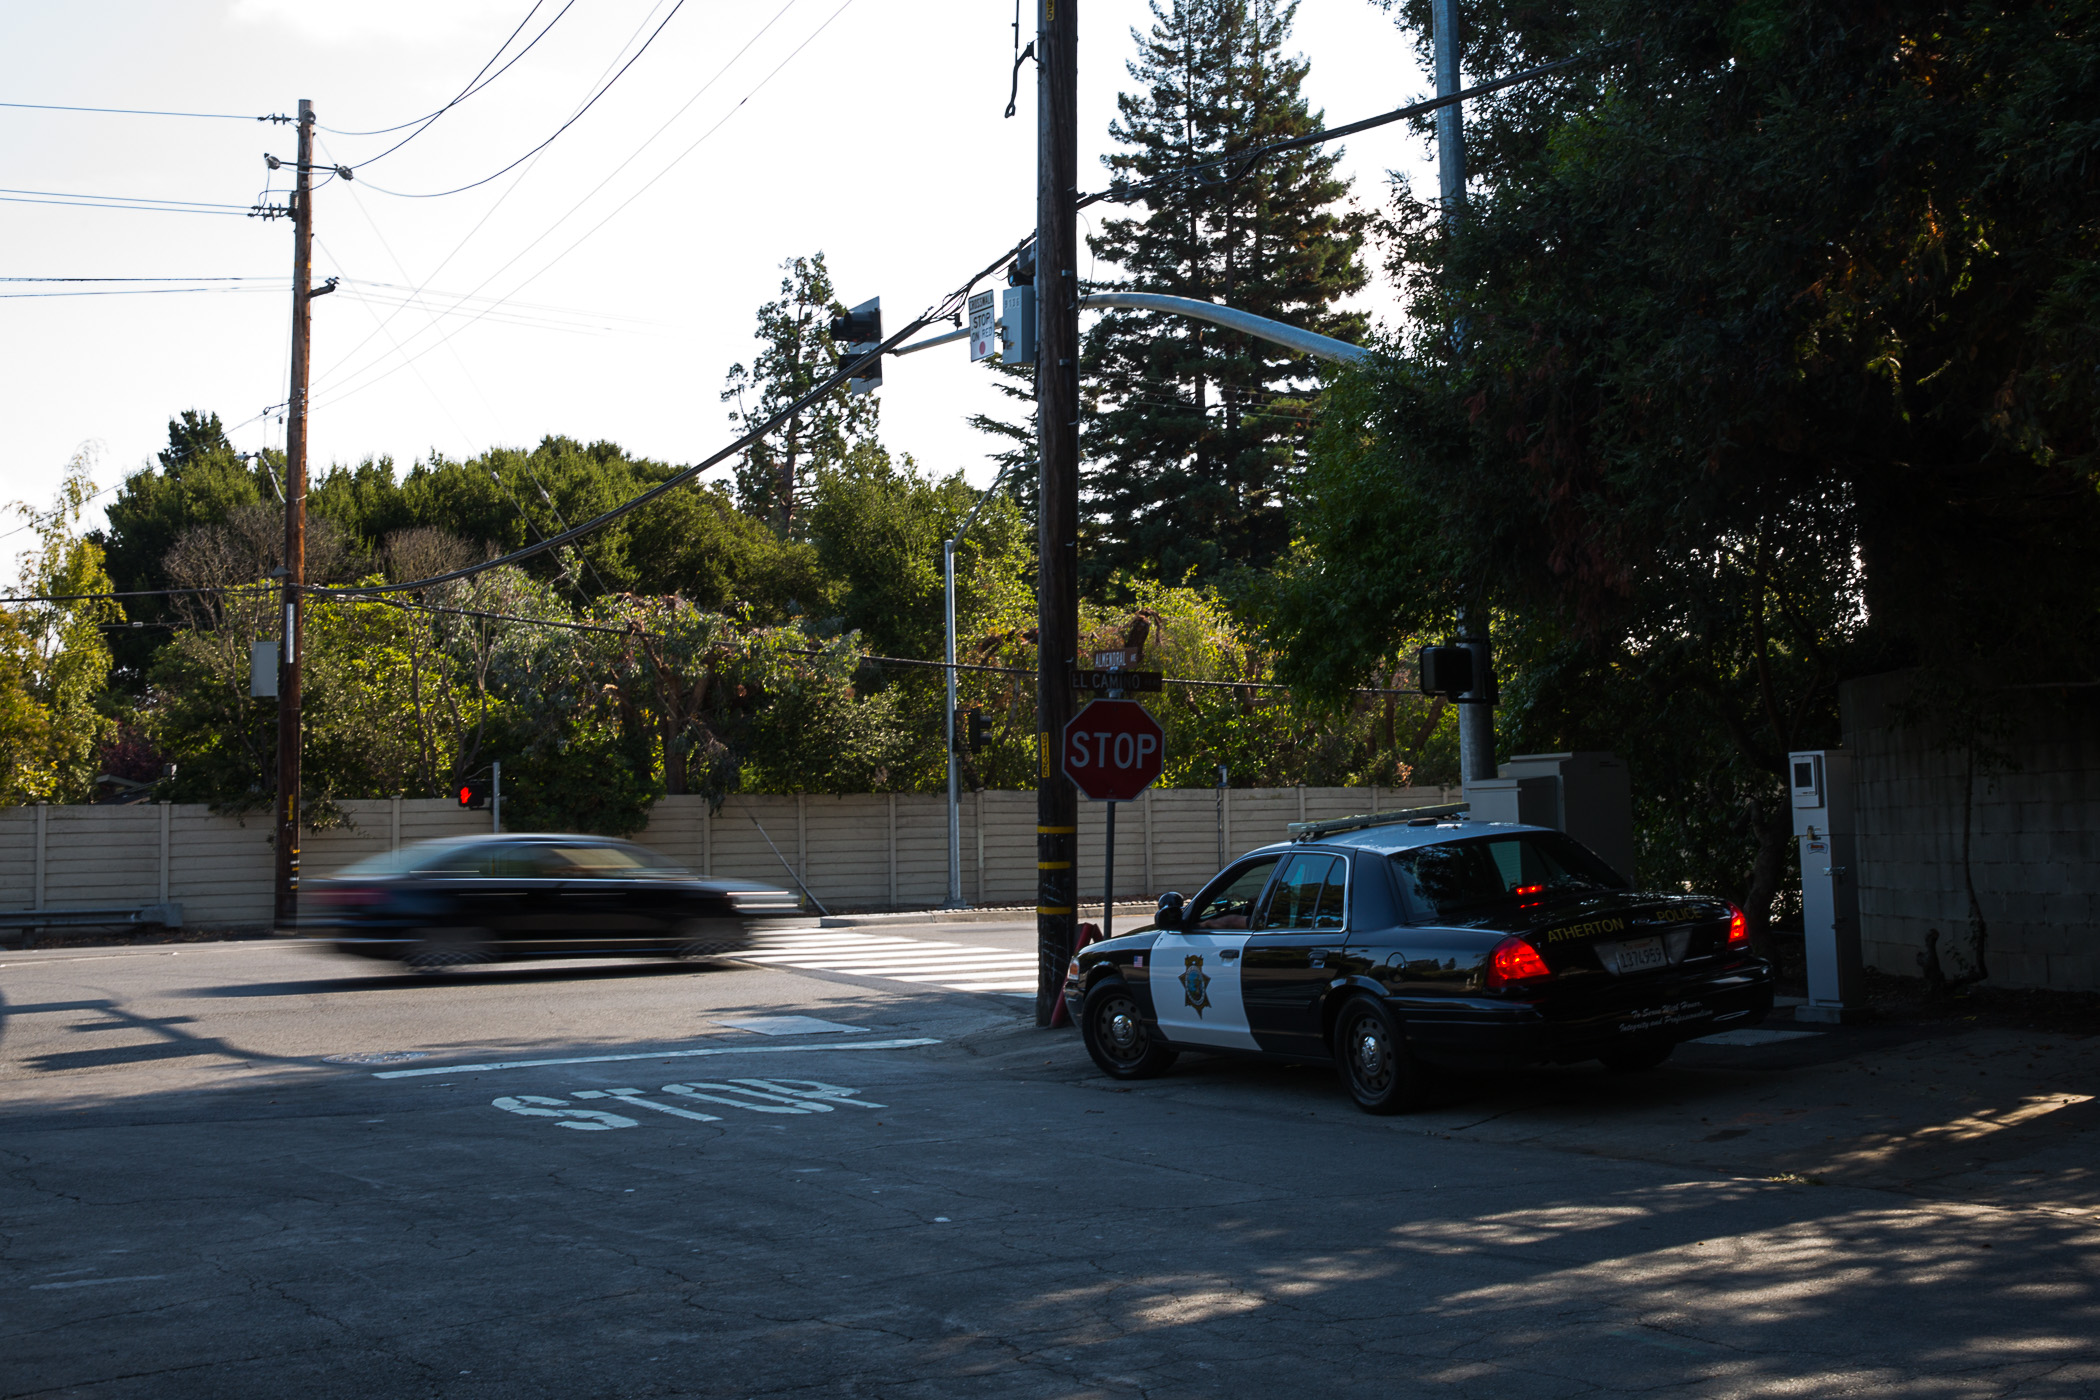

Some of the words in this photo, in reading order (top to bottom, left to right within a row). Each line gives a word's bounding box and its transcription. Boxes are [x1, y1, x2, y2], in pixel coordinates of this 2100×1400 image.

[973, 312, 991, 329] STOP
[972, 331, 980, 343] ON
[982, 326, 992, 338] RED
[1072, 673, 1088, 688] EL
[1092, 673, 1140, 689] CAMINO
[1070, 731, 1157, 770] STOP
[1547, 917, 1625, 943] ATHERTON
[1656, 907, 1703, 923] POLICE
[1620, 947, 1662, 968] 1374959
[1631, 1009, 1641, 1019] To
[1619, 1021, 1649, 1032] Integrity
[491, 1078, 888, 1131] STOP
